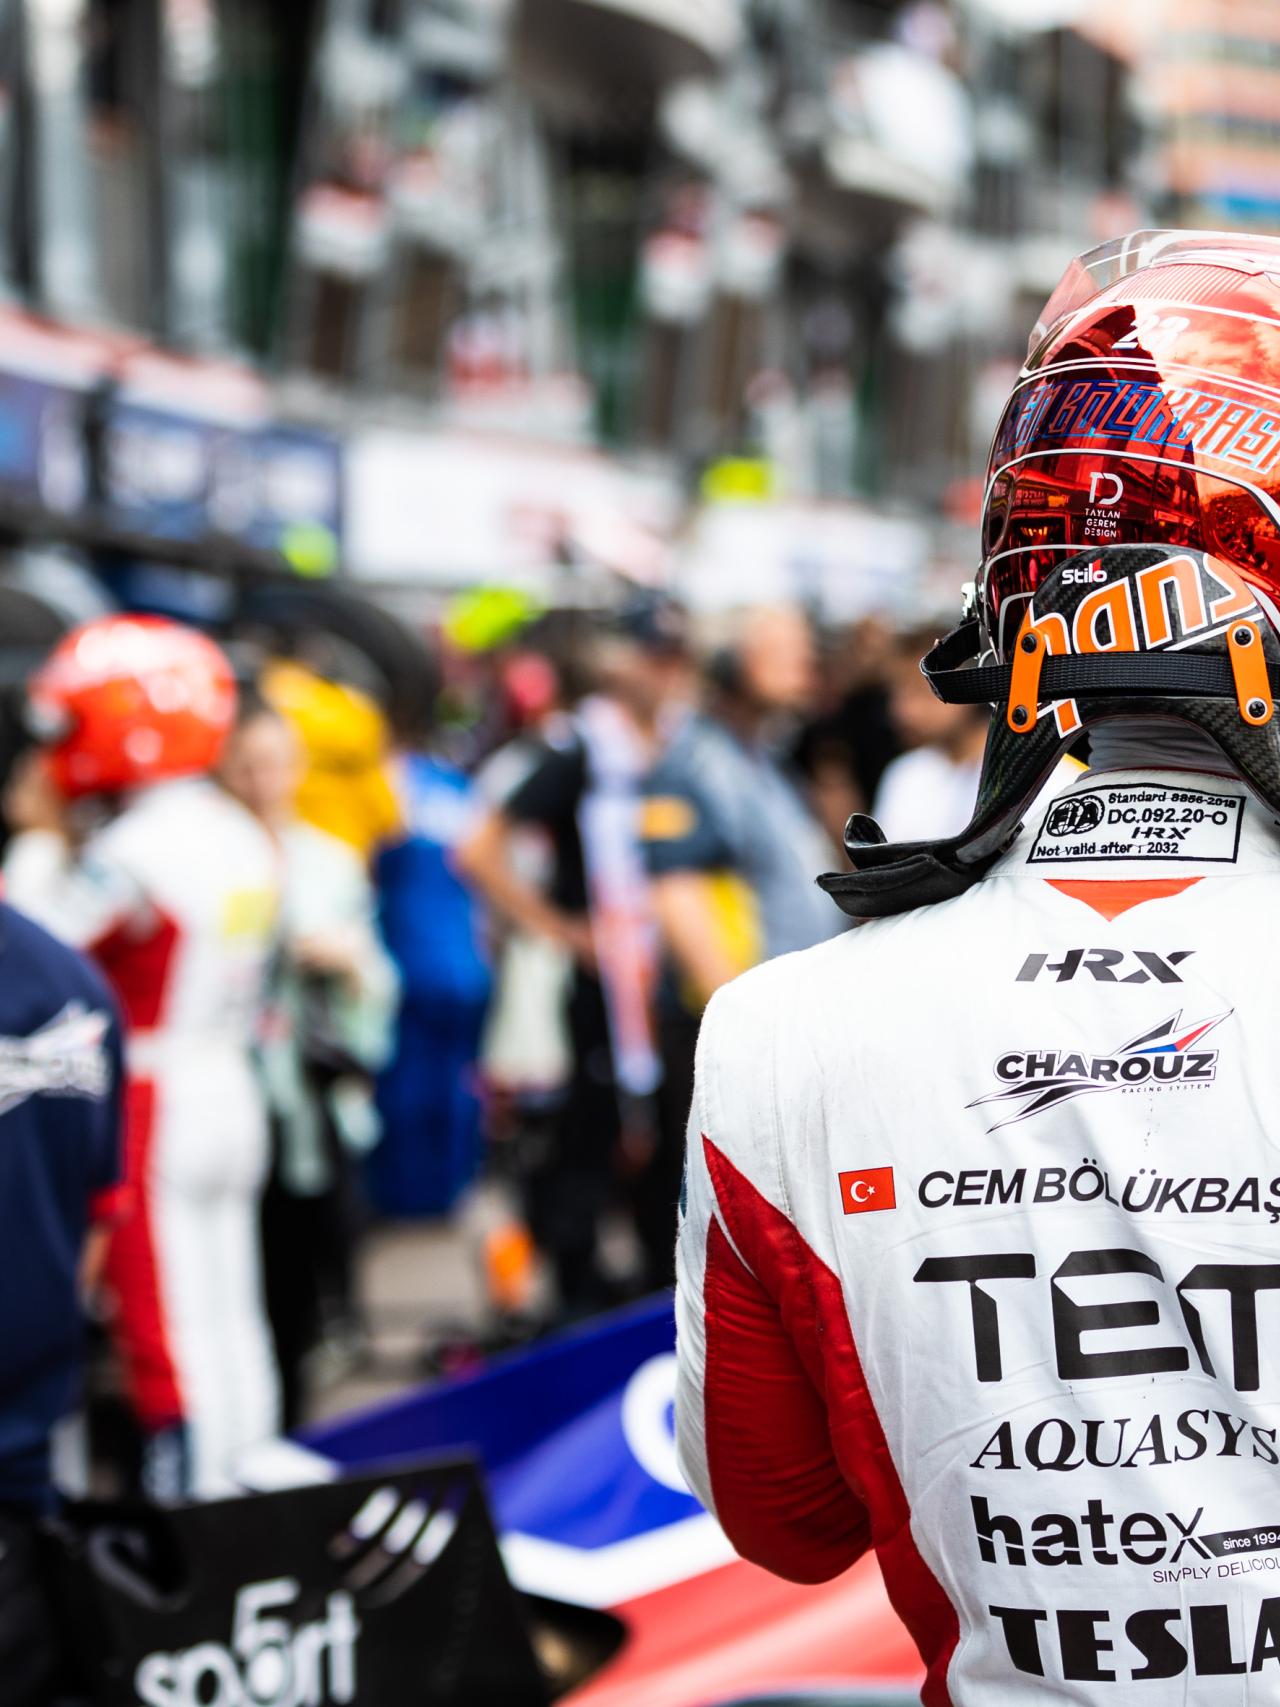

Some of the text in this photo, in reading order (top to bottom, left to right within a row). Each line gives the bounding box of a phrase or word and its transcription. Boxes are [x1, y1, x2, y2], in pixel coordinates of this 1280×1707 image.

[1084, 508, 1120, 519] TAYLAN
[1086, 518, 1117, 529] GEREM
[1084, 527, 1117, 538] DESIGN
[1108, 791, 1236, 808] Standard 8856-2018
[1131, 827, 1192, 840] HRX
[1036, 845, 1060, 857] Not
[1065, 842, 1096, 855] valid
[1100, 841, 1133, 853] after
[1147, 842, 1179, 854] 2032
[1015, 948, 1197, 983] HRX
[998, 1052, 1215, 1082] CHAROUZ
[1121, 1083, 1211, 1094] RACING SYSTEM
[917, 1169, 1024, 1207] CEM
[969, 1409, 1280, 1472] AQUASYS
[970, 1495, 1212, 1566] hatex
[1223, 1538, 1251, 1551] since
[1153, 1566, 1211, 1583] SIMPLY
